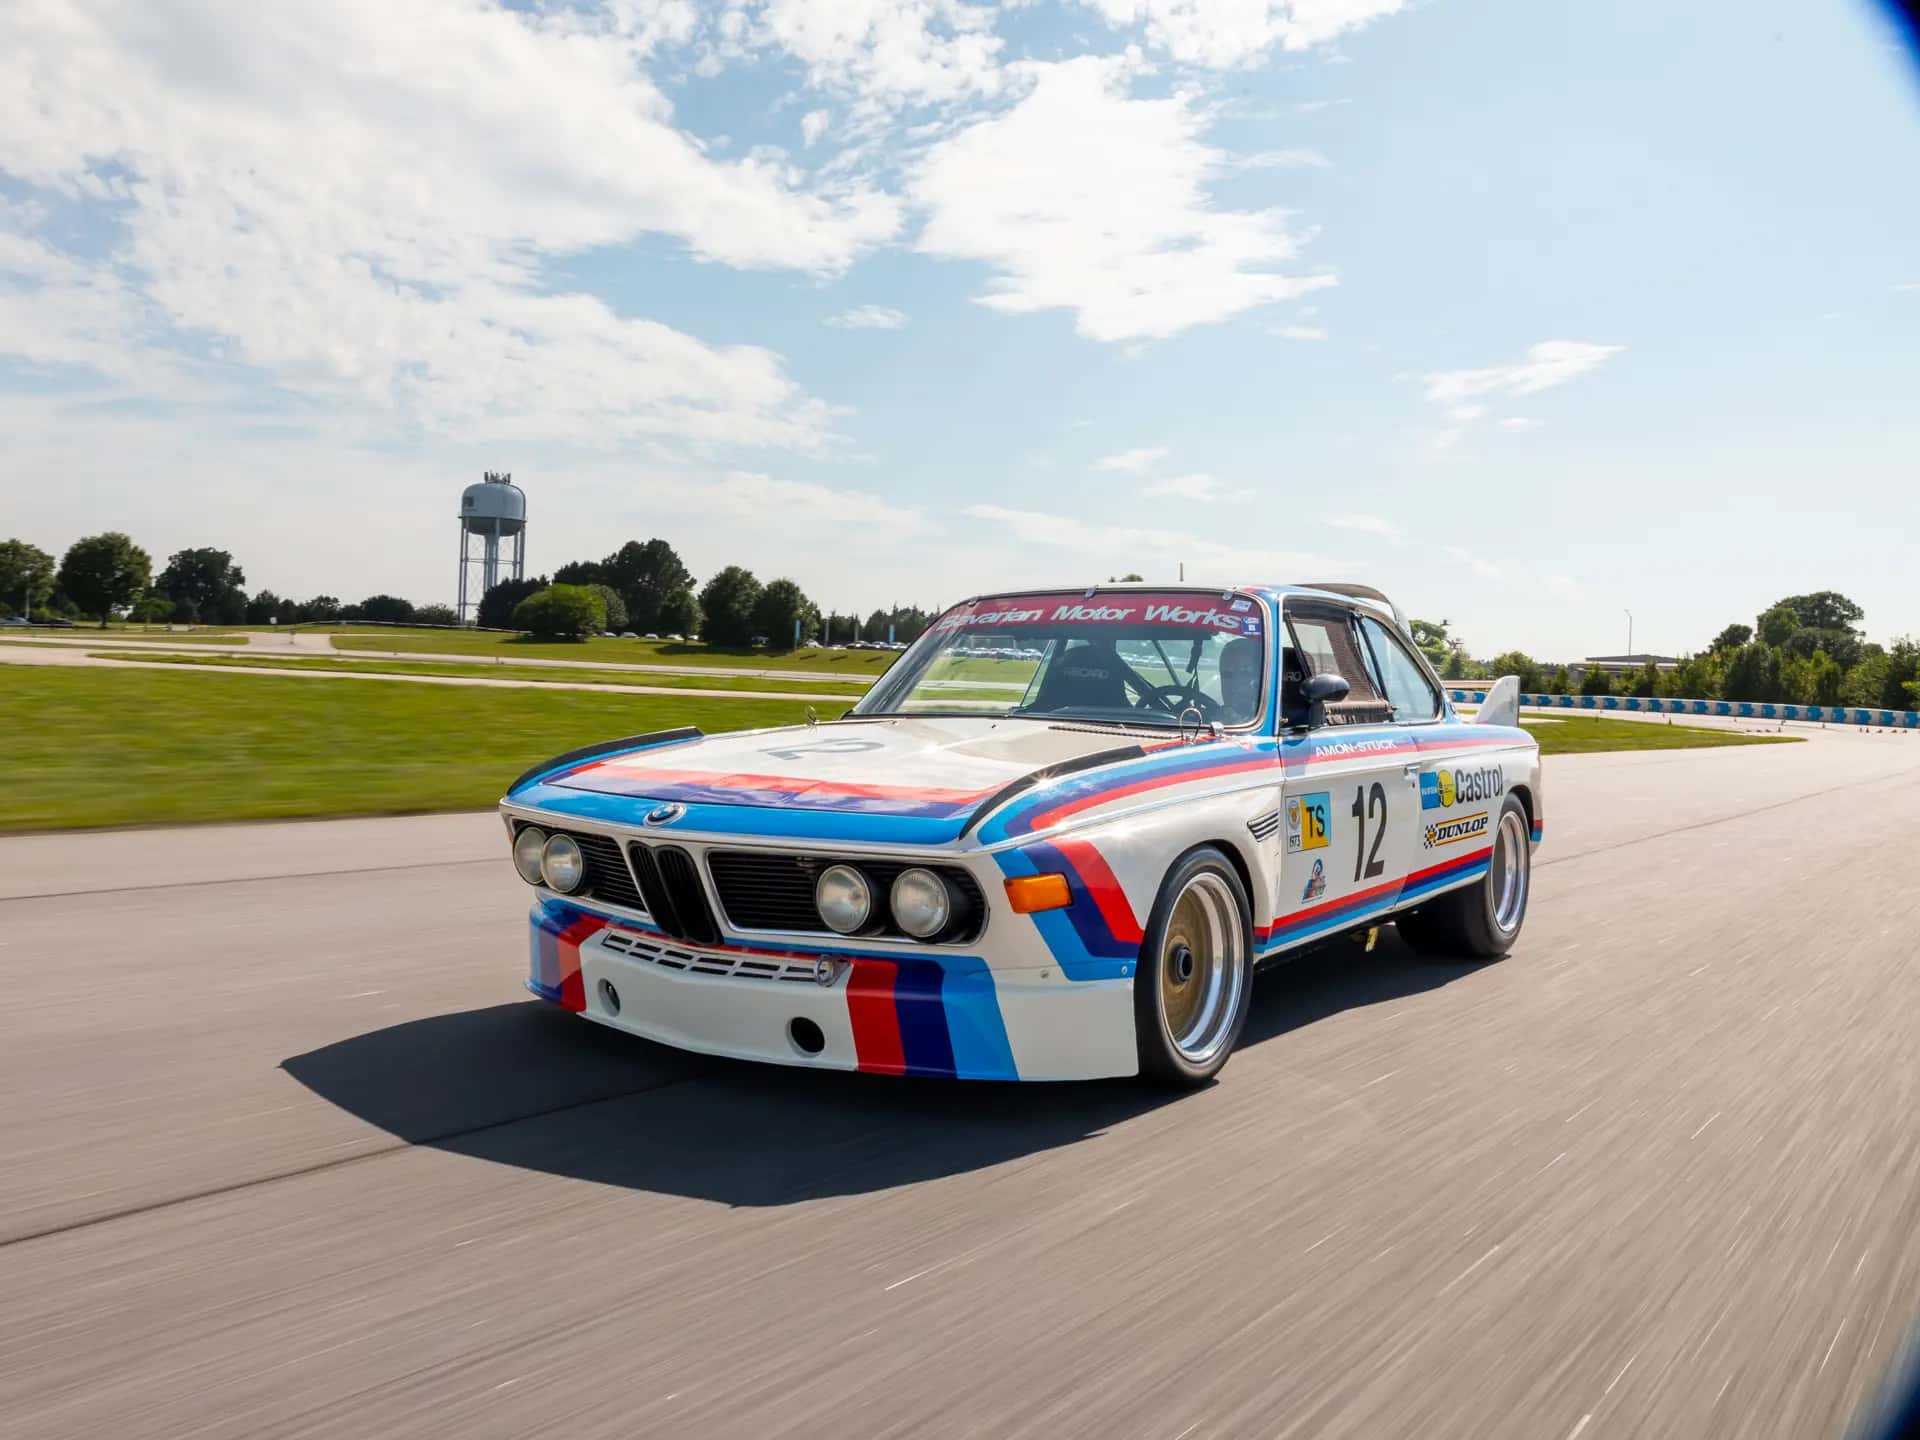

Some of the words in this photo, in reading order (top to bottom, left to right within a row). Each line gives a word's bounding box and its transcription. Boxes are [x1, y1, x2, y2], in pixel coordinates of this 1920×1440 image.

[937, 608, 1043, 630] Bavarian
[1051, 605, 1136, 622] Motor
[1144, 605, 1242, 629] Works
[1455, 764, 1504, 804] Castrol
[1306, 804, 1326, 838] TS
[1351, 782, 1388, 882] 12
[1437, 816, 1488, 841] DUNLOP
